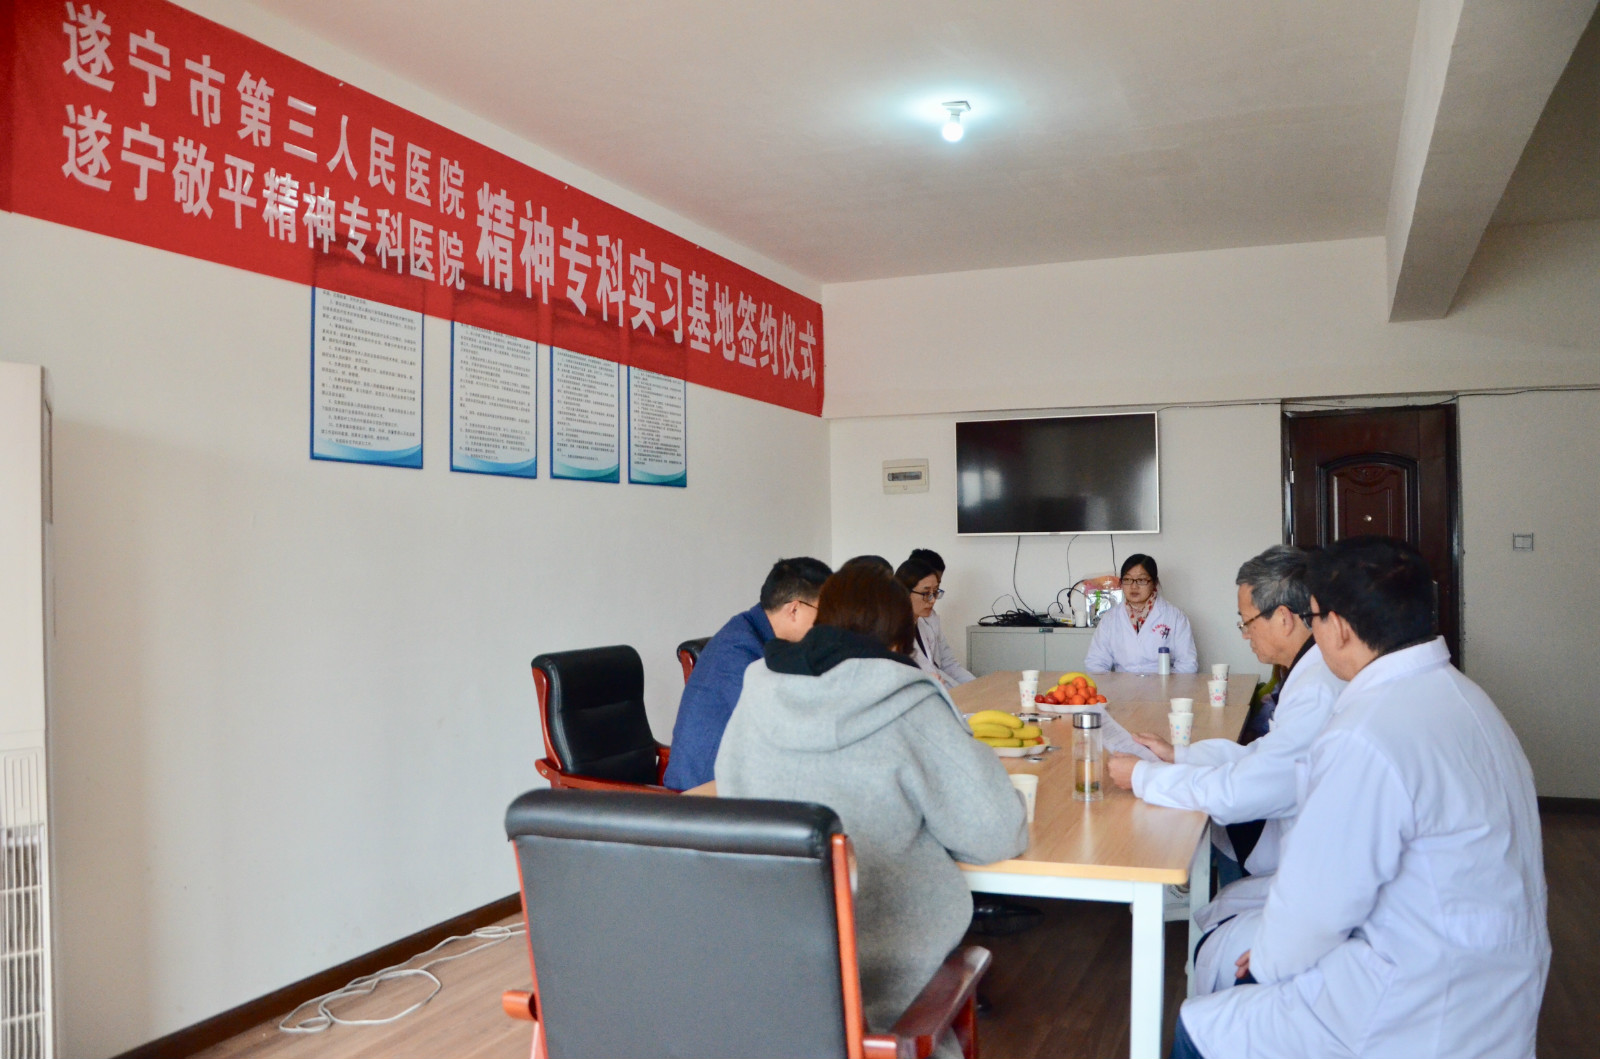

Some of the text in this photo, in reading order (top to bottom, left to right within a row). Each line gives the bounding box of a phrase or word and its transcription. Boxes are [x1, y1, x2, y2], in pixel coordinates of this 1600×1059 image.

[62, 1, 465, 219] 遂宁市第三人民医院
[62, 104, 465, 291] 遂宁敬平精神专科医院
[476, 181, 817, 388] 精神专科实习基地签约仪式
